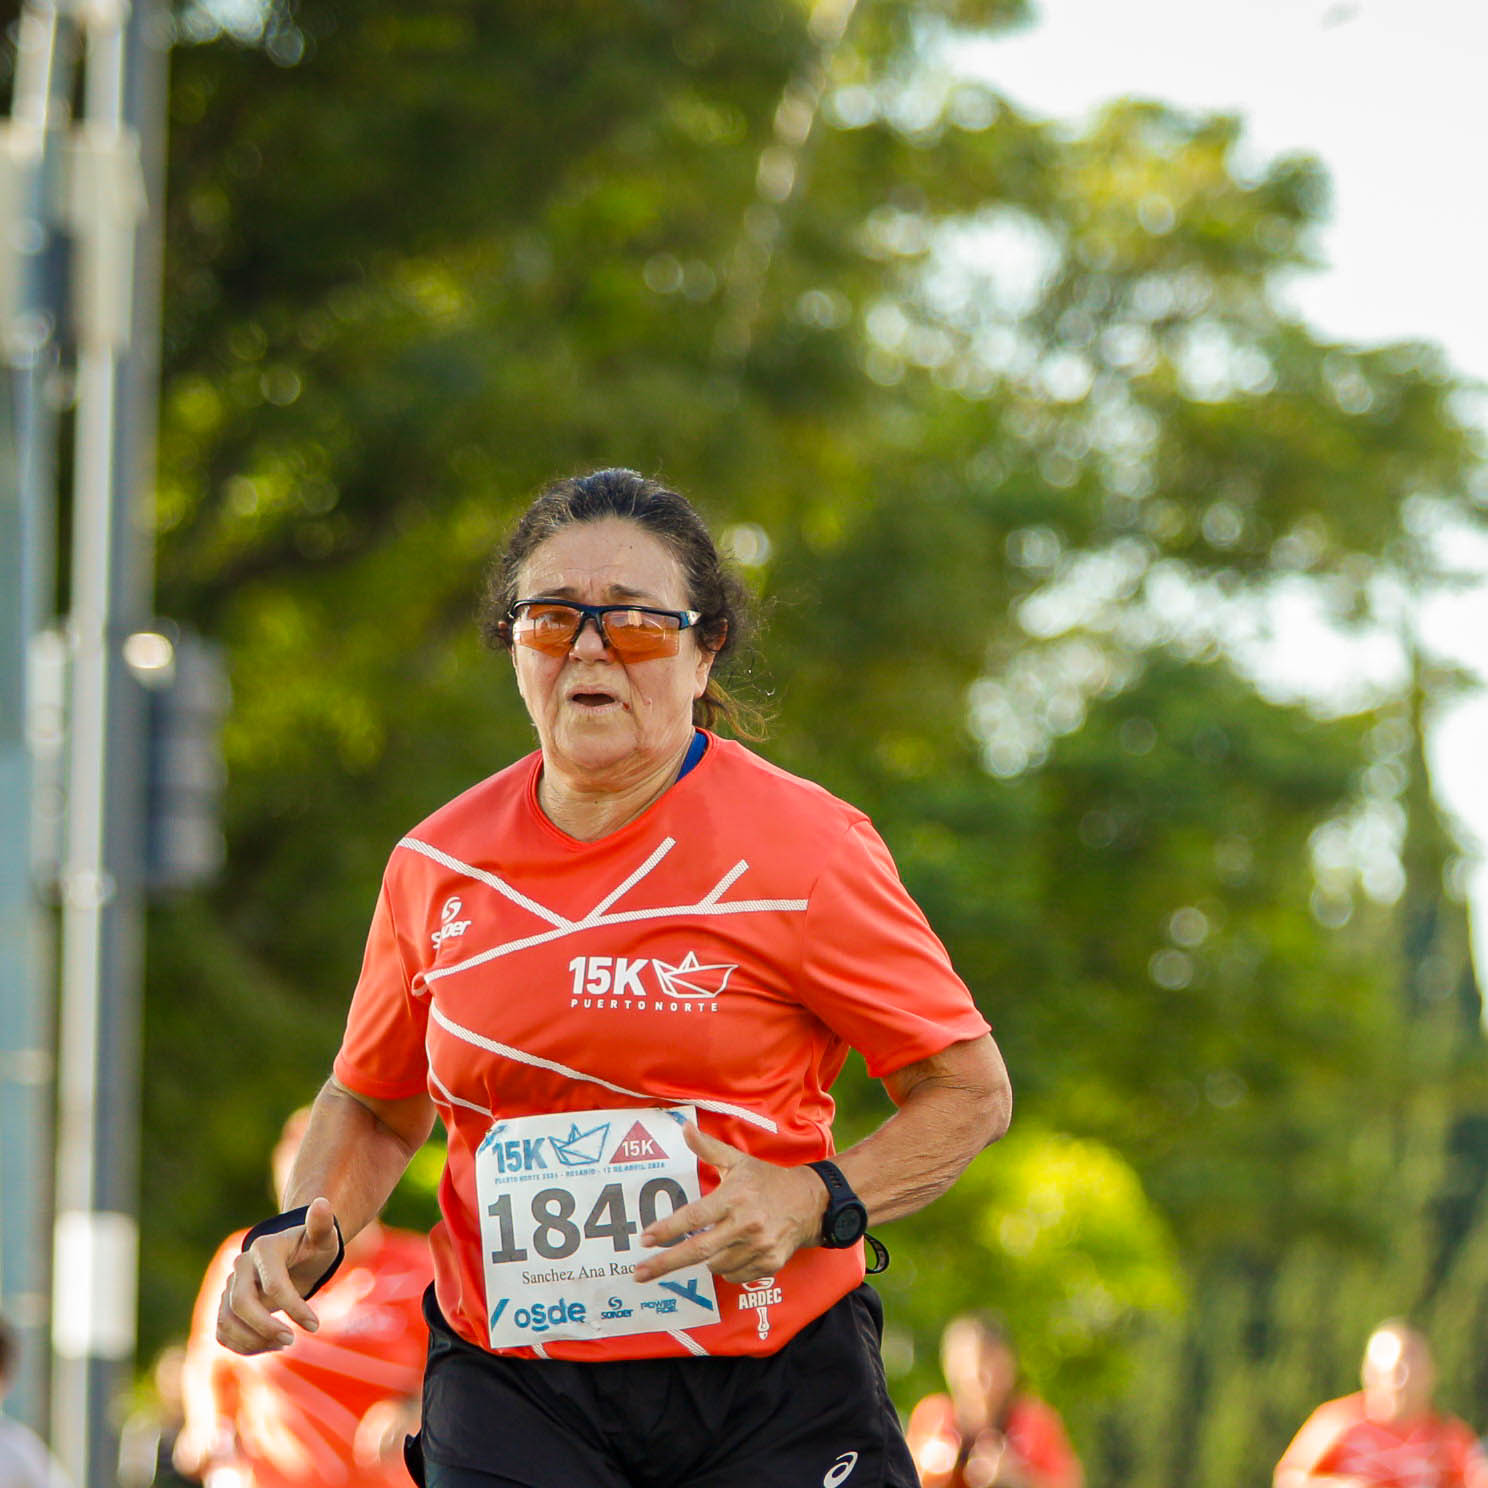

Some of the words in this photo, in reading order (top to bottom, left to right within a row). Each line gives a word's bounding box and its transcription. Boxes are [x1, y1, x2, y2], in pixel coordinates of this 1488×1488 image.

[568, 956, 649, 996] 15K
[570, 999, 646, 1010] PUERTO
[655, 1001, 718, 1012] NORTE
[492, 1137, 548, 1174] 15K
[621, 1139, 654, 1157] 15K
[487, 1177, 689, 1264] 1840
[522, 1268, 575, 1284] Sanchez
[578, 1266, 606, 1280] Ana
[738, 1287, 782, 1310] ARDEC
[514, 1297, 586, 1332] osde
